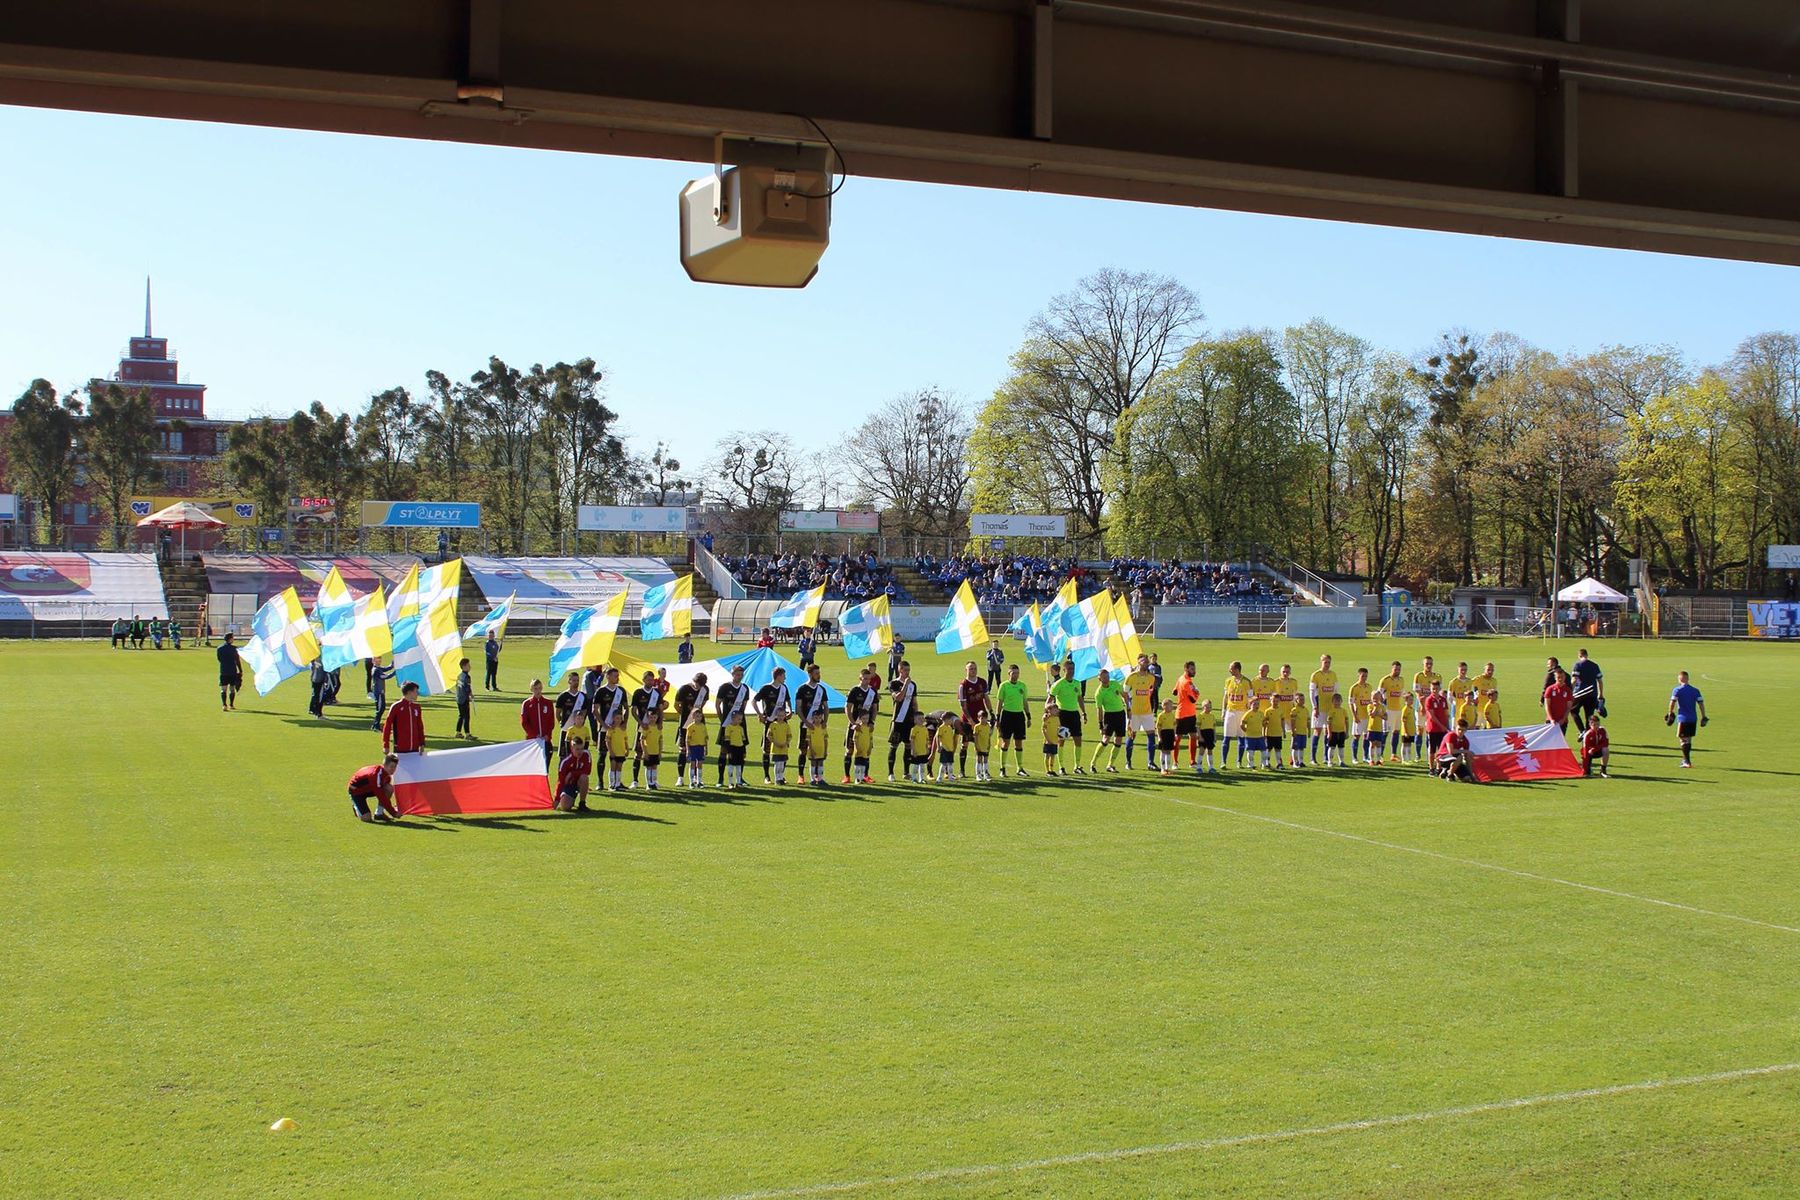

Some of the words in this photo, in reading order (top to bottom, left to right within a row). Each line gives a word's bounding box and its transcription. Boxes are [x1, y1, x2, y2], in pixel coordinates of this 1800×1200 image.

[301, 498, 328, 507] 15:57
[981, 520, 1009, 530] Thomas
[1028, 521, 1055, 531] Thomas
